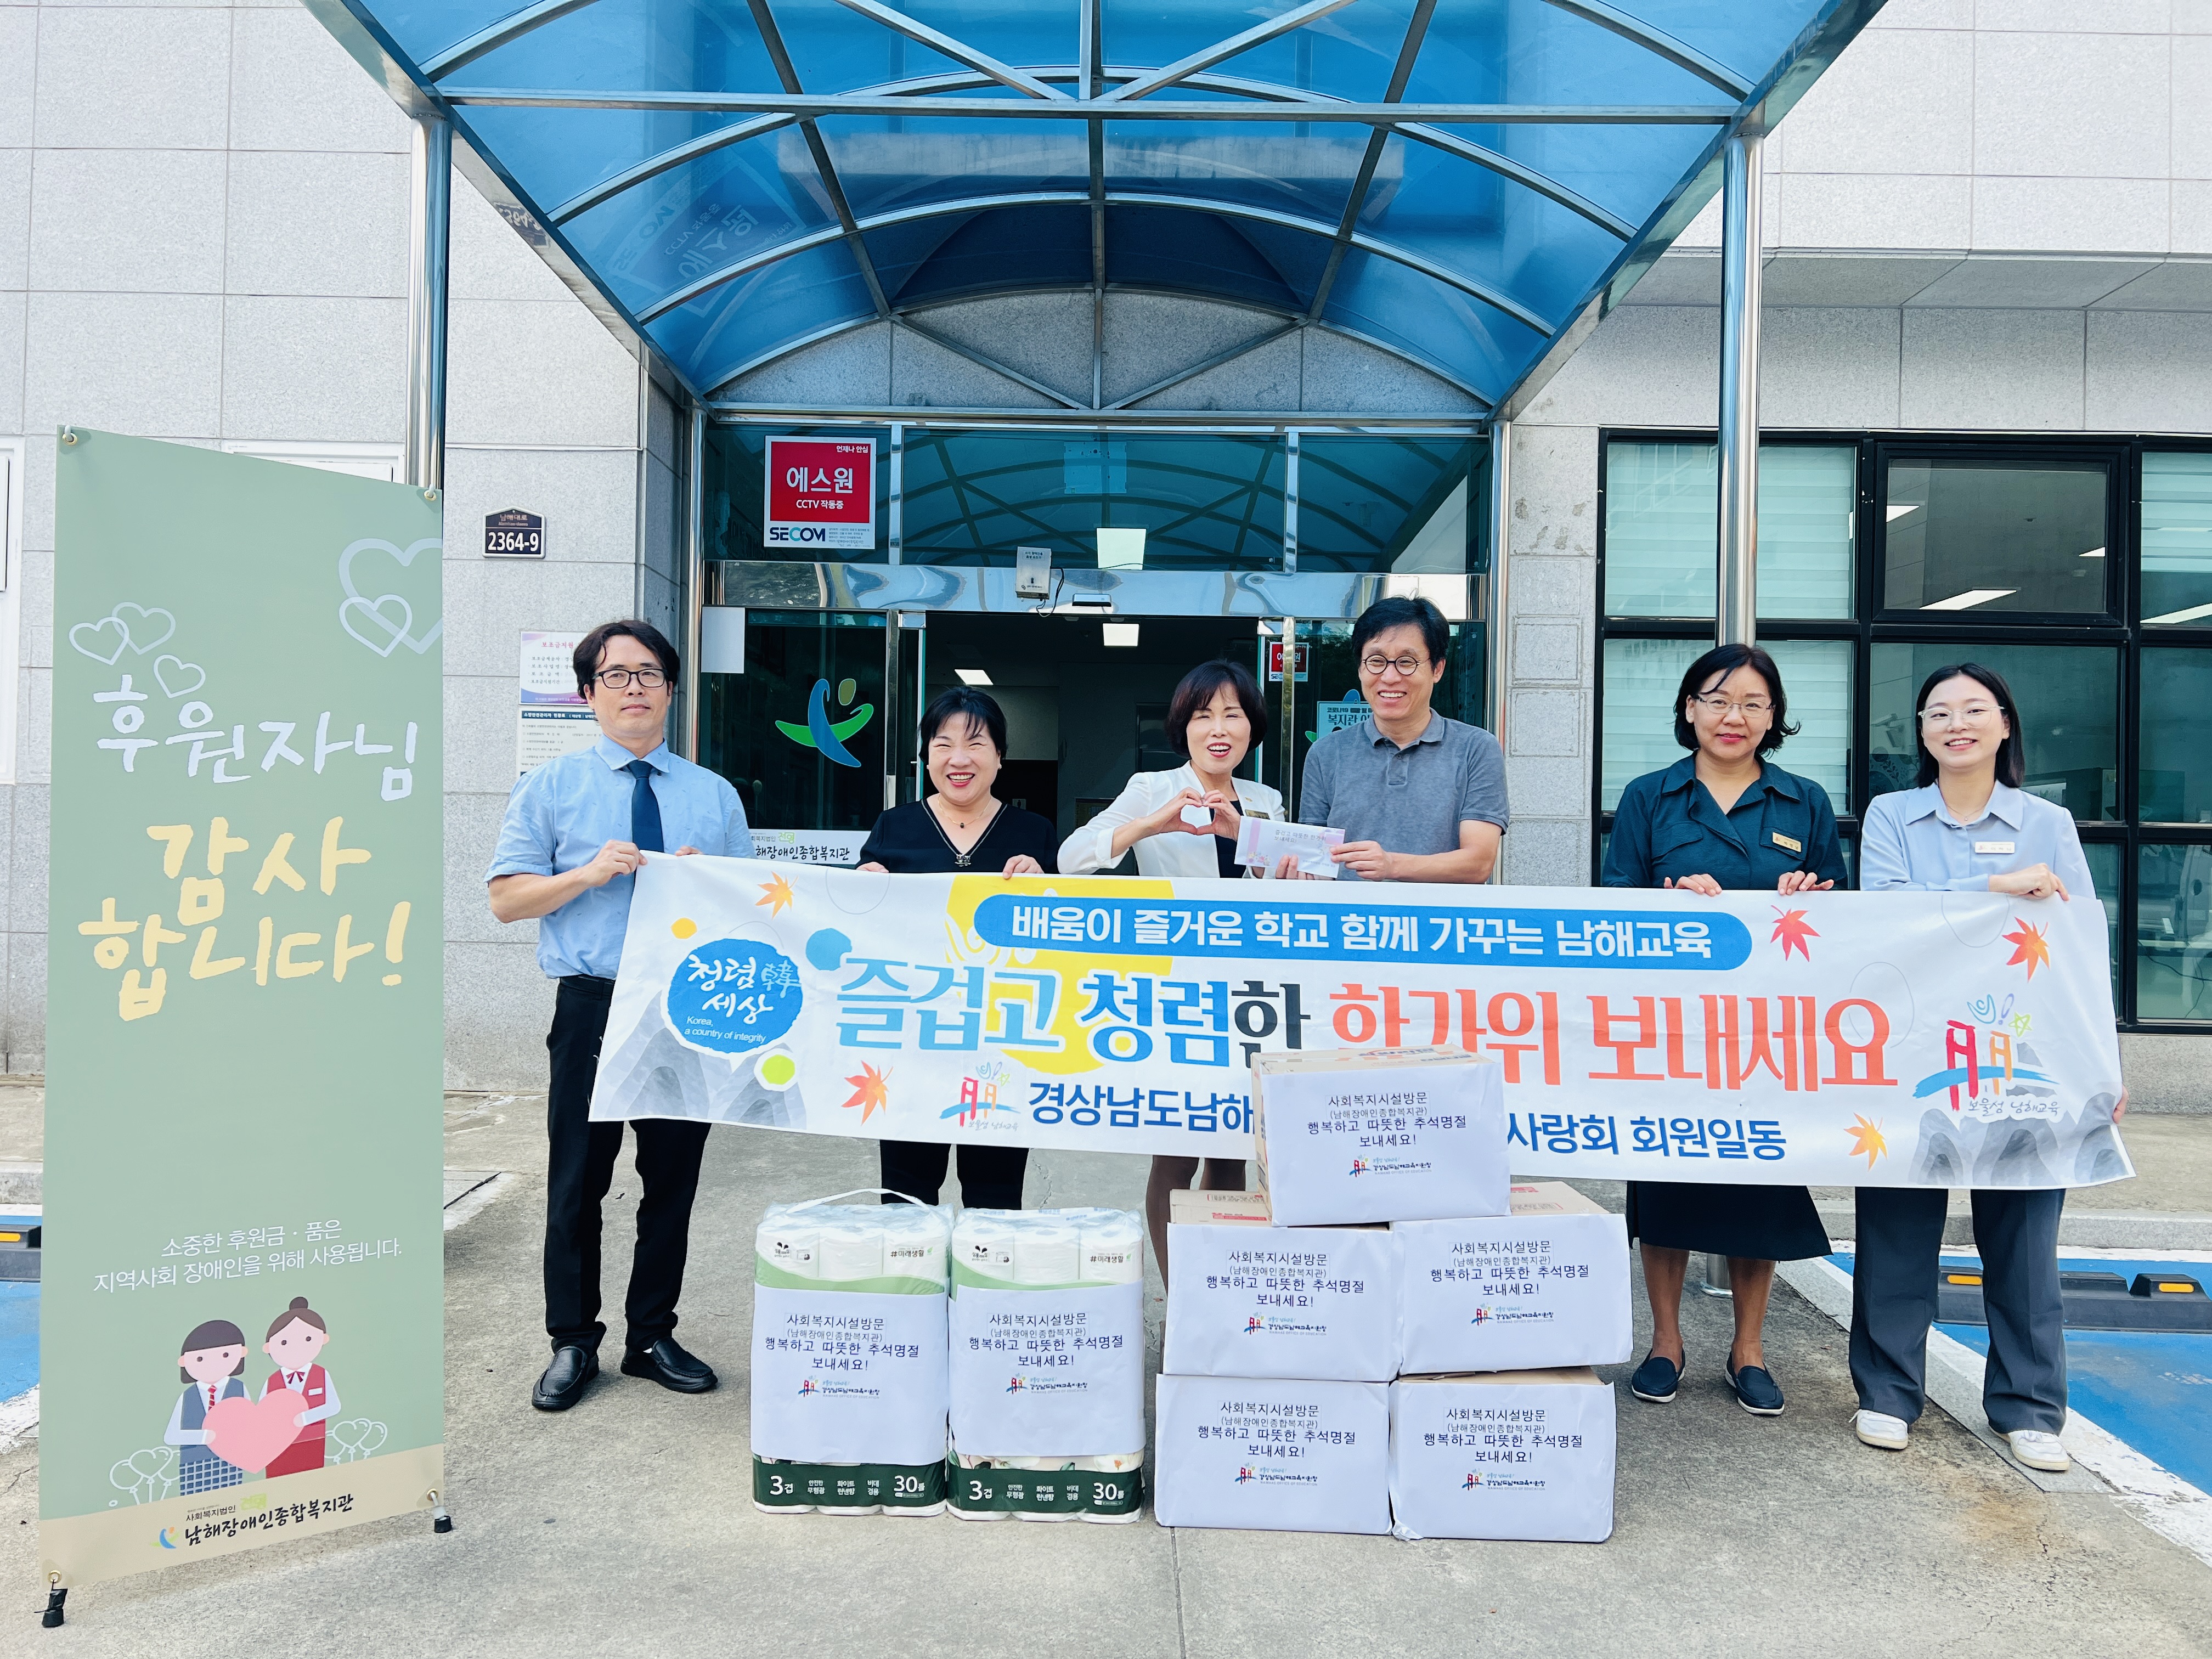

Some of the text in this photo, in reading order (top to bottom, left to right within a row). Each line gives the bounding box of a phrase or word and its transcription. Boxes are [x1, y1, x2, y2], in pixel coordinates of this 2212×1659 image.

[786, 467, 853, 494] 에스원
[796, 500, 844, 509] CCTV 작동중
[488, 531, 539, 552] 2364-9
[770, 527, 826, 542] SECOM
[1328, 714, 1358, 725] 복지관
[93, 674, 418, 801] 후원자님
[755, 845, 850, 861] 해장애인종합복지관
[146, 816, 371, 926] 감사
[1012, 905, 1712, 958] 배움이 즐거운 학교 함께 가꾸는 남해교육
[78, 897, 411, 1022] 합니다!
[702, 992, 774, 1025] 세상
[686, 1015, 714, 1028] Korea,
[836, 958, 1059, 1051] 즐겁고
[1080, 974, 1311, 1069] 청렴한
[1587, 994, 1898, 1092] 보내세요
[684, 1028, 691, 1036] a
[692, 1029, 724, 1041] country
[733, 1032, 766, 1044] integrity
[1329, 1092, 1427, 1107] 사회복지시설방문
[1968, 1098, 2061, 1116] 보물섬 남해교육
[1330, 1107, 1427, 1120] (남해장애인종합복지관)
[1307, 1115, 1466, 1135] 행복하고 따뜻한 추석명절
[1359, 1133, 1417, 1148] 보내세요!
[1507, 1113, 1619, 1155] 사랑회
[1630, 1116, 1787, 1160] 회원일동
[160, 1218, 342, 1257] 소중한 후원금 품은
[1452, 1240, 1551, 1255] 사회복지시설방문
[93, 1237, 403, 1293] 지역사회 장애인을 위해 사용됩니다.
[1228, 1251, 1328, 1266] 사회복지시설방문
[1453, 1255, 1551, 1267] (남해장애인종합복지관)
[1229, 1266, 1327, 1279] (남해장애인종합복지관)
[1430, 1264, 1589, 1282] 행복하고 따뜻한 추석명절
[1206, 1276, 1364, 1294] 행복하고 따뜻한 추석명절
[1482, 1283, 1539, 1296] 보내세요!
[1256, 1294, 1314, 1308] 보내세요!
[787, 1314, 884, 1330] 사회복지시설방문
[990, 1313, 1087, 1326] 사회복지시설방문
[787, 1329, 883, 1342] (남해장애인종합복지관)
[990, 1328, 1086, 1339] (남해장애인종합복지관)
[765, 1336, 919, 1358] 행복하고 따뜻한 추석명절
[969, 1335, 1123, 1352] 행복하고 따뜻한 추석명절
[811, 1358, 868, 1371] 보내세요!
[1018, 1355, 1074, 1368] 보내세요!
[1221, 1401, 1319, 1417] 사회복지시설방문
[1446, 1408, 1546, 1422] 사회복지시설방문
[1221, 1416, 1318, 1429] (남해장애인종합복지관)
[1447, 1423, 1545, 1434] (남해장애인종합복지관)
[1198, 1426, 1356, 1444] 행복하고 따뜻한 추석명절
[1424, 1433, 1583, 1448] 행복하고 따뜻한 추석명절
[1248, 1444, 1305, 1458] 보내세요!
[1475, 1450, 1532, 1463] 보내세요!
[184, 1493, 354, 1546] 남해장애인종합복지관
[185, 1504, 236, 1521] 사회복지법인
